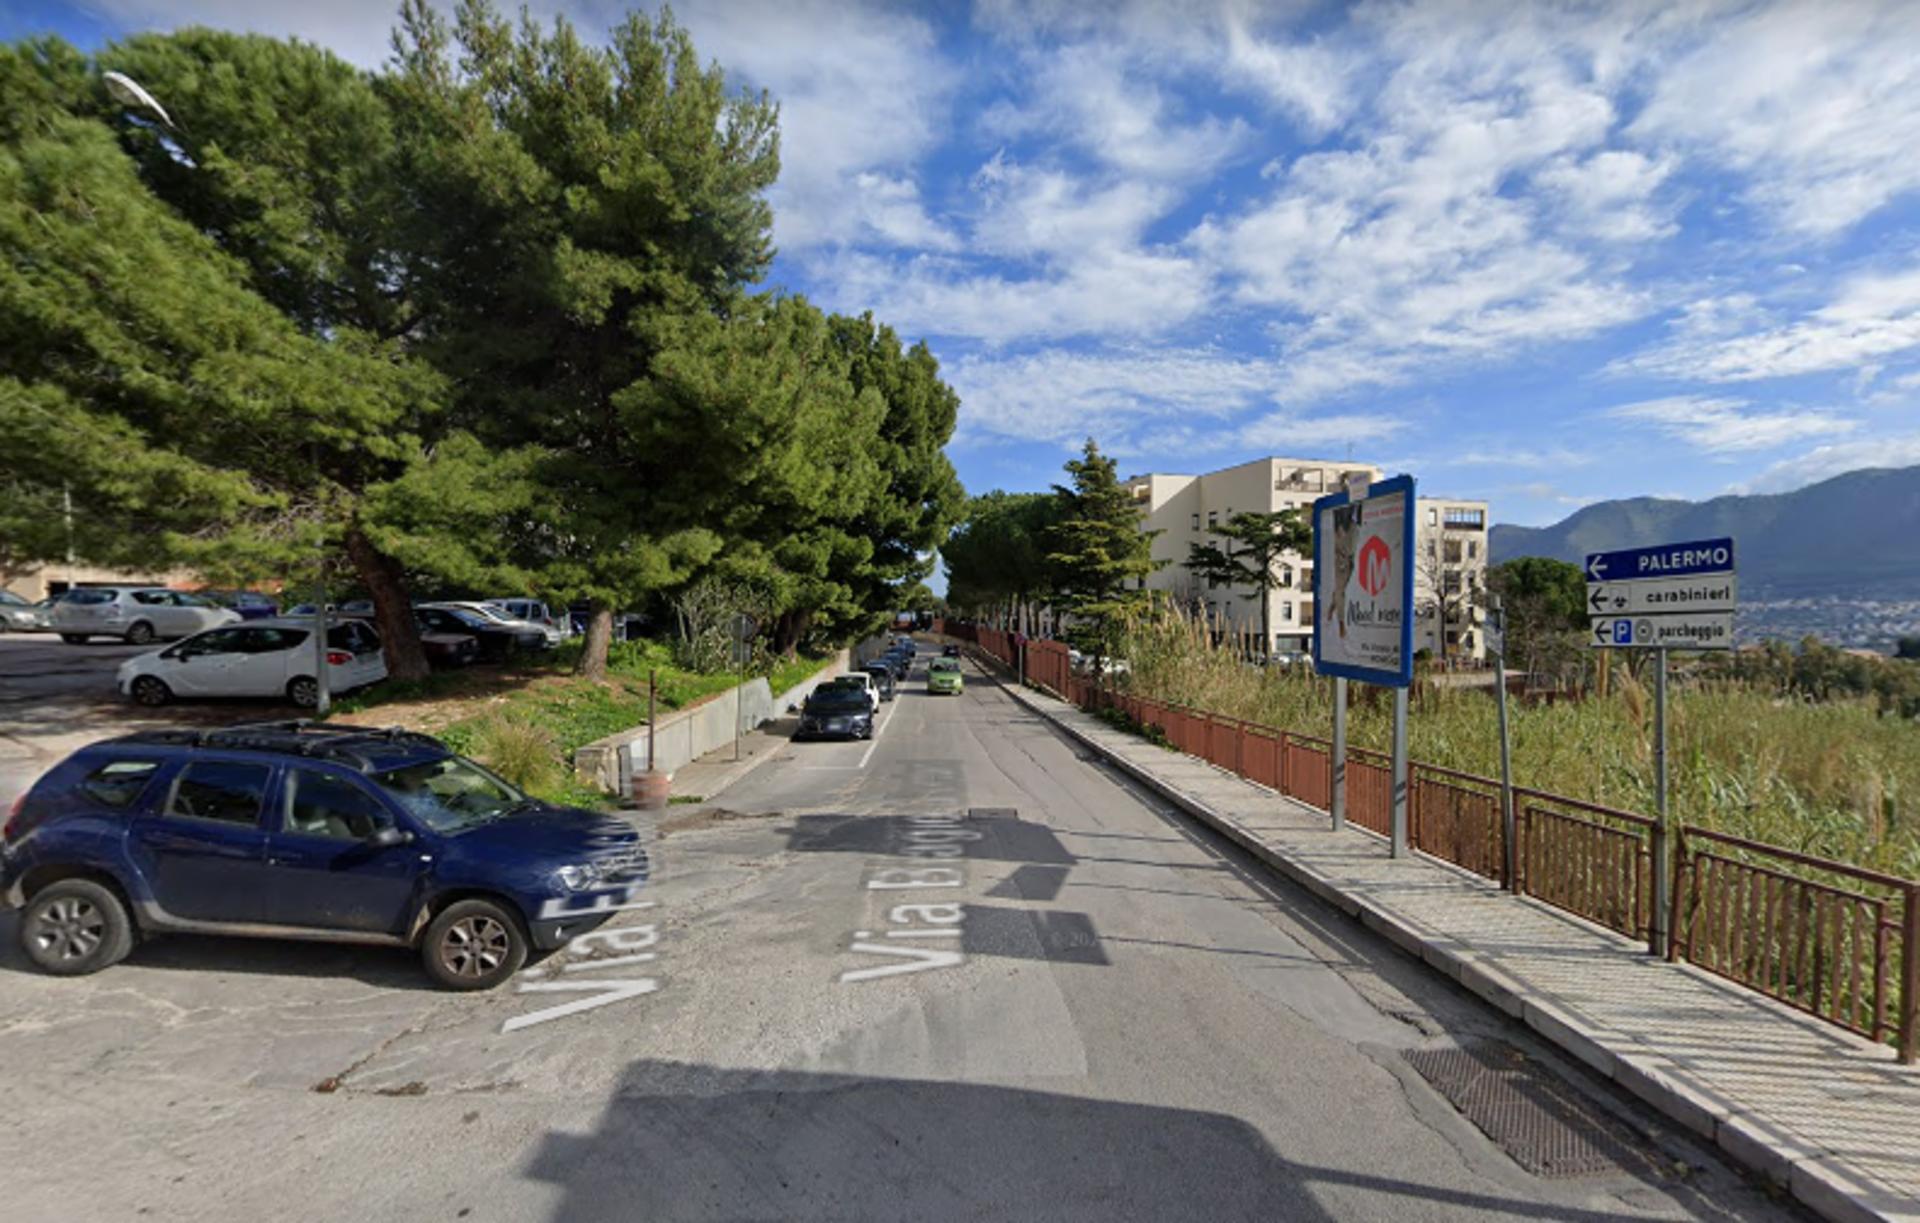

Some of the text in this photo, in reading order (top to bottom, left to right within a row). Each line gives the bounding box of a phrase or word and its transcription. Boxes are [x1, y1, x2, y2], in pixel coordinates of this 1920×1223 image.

[1638, 547, 1729, 571] PALERMO
[1646, 585, 1730, 603] carabinieri
[1657, 622, 1724, 642] parcheggio
